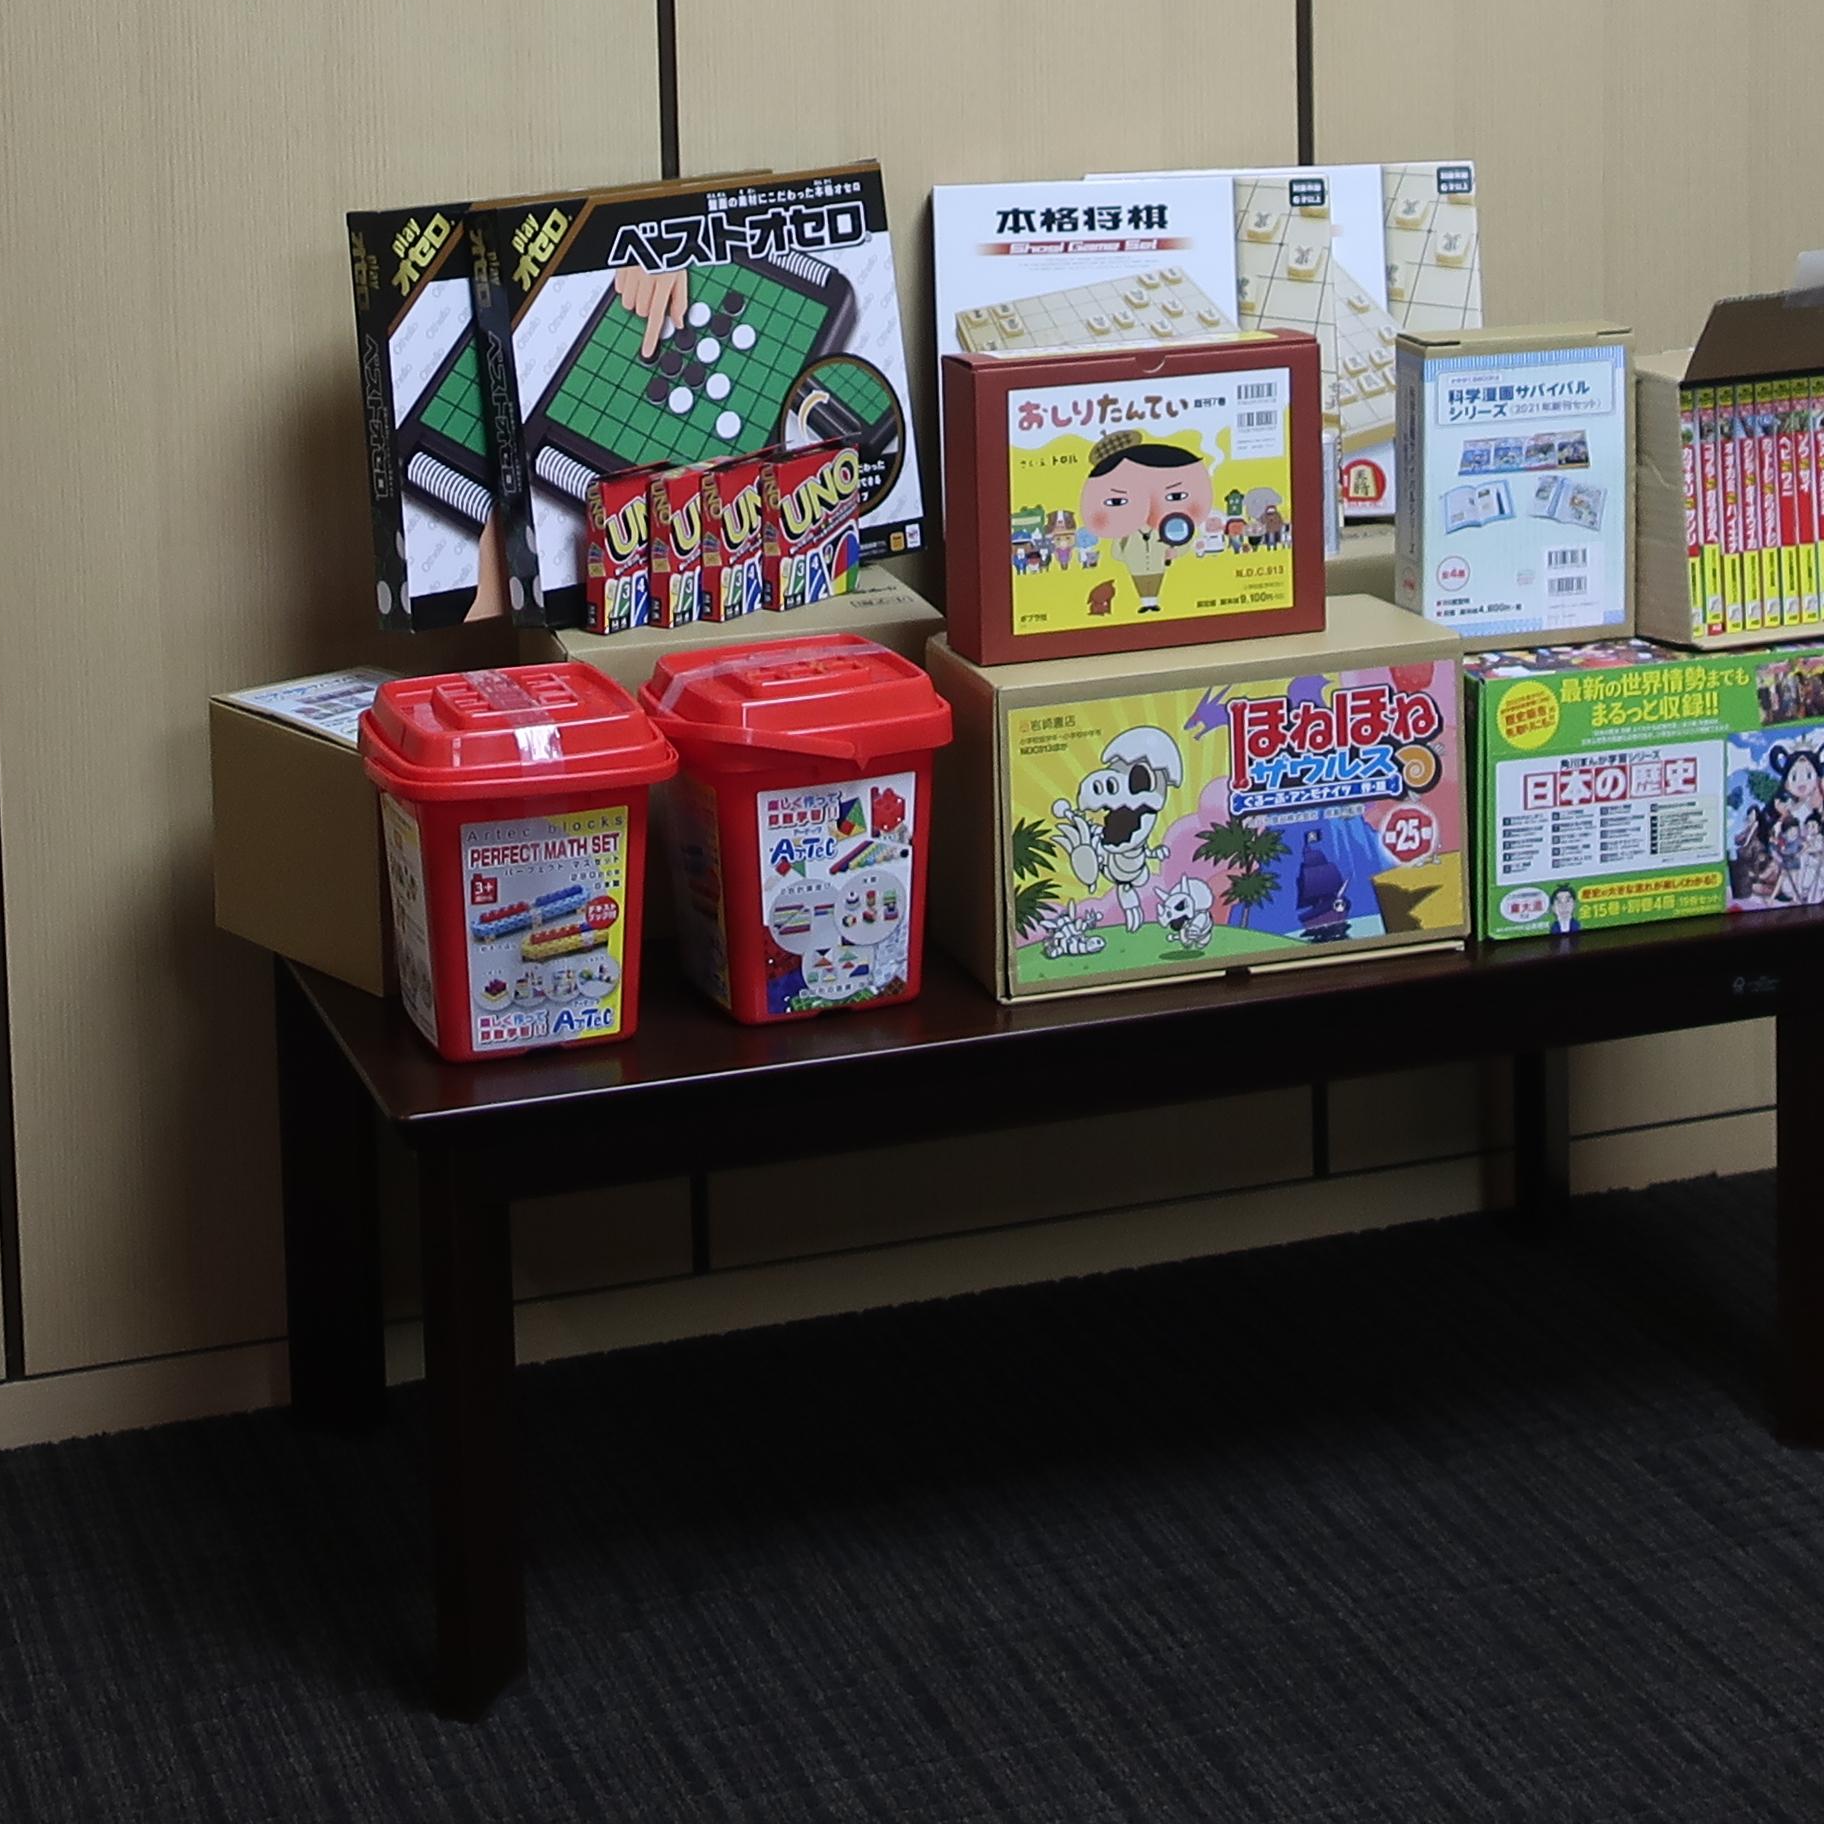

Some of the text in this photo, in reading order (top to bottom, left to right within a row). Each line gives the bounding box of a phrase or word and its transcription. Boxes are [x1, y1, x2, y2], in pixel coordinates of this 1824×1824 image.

[391, 218, 421, 258] play
[511, 213, 539, 254] play
[607, 201, 867, 274] ベストオセロ
[995, 204, 1169, 235] 本格将棋
[391, 212, 452, 297] オセロ
[511, 207, 570, 292] オセロ
[1067, 240, 1121, 254] Game
[1448, 380, 1591, 405] 科学漫画サバイバル
[1017, 393, 1190, 432] おしりたんてい
[1449, 403, 1508, 422] シリーズ
[721, 477, 762, 553] UN
[778, 447, 860, 544] UNO
[604, 492, 649, 564] UN
[797, 552, 819, 576] 3 4
[622, 578, 646, 599] 3 4
[1560, 665, 1750, 704] 最新の世界情勢までも
[1229, 684, 1439, 789] ほねほね
[1251, 744, 1398, 791] ザウルス
[1526, 757, 1698, 810] 日本の歴史
[467, 815, 624, 842] Artec blocks
[470, 832, 620, 868] PERFECT MATH SET
[474, 881, 495, 894] 3+
